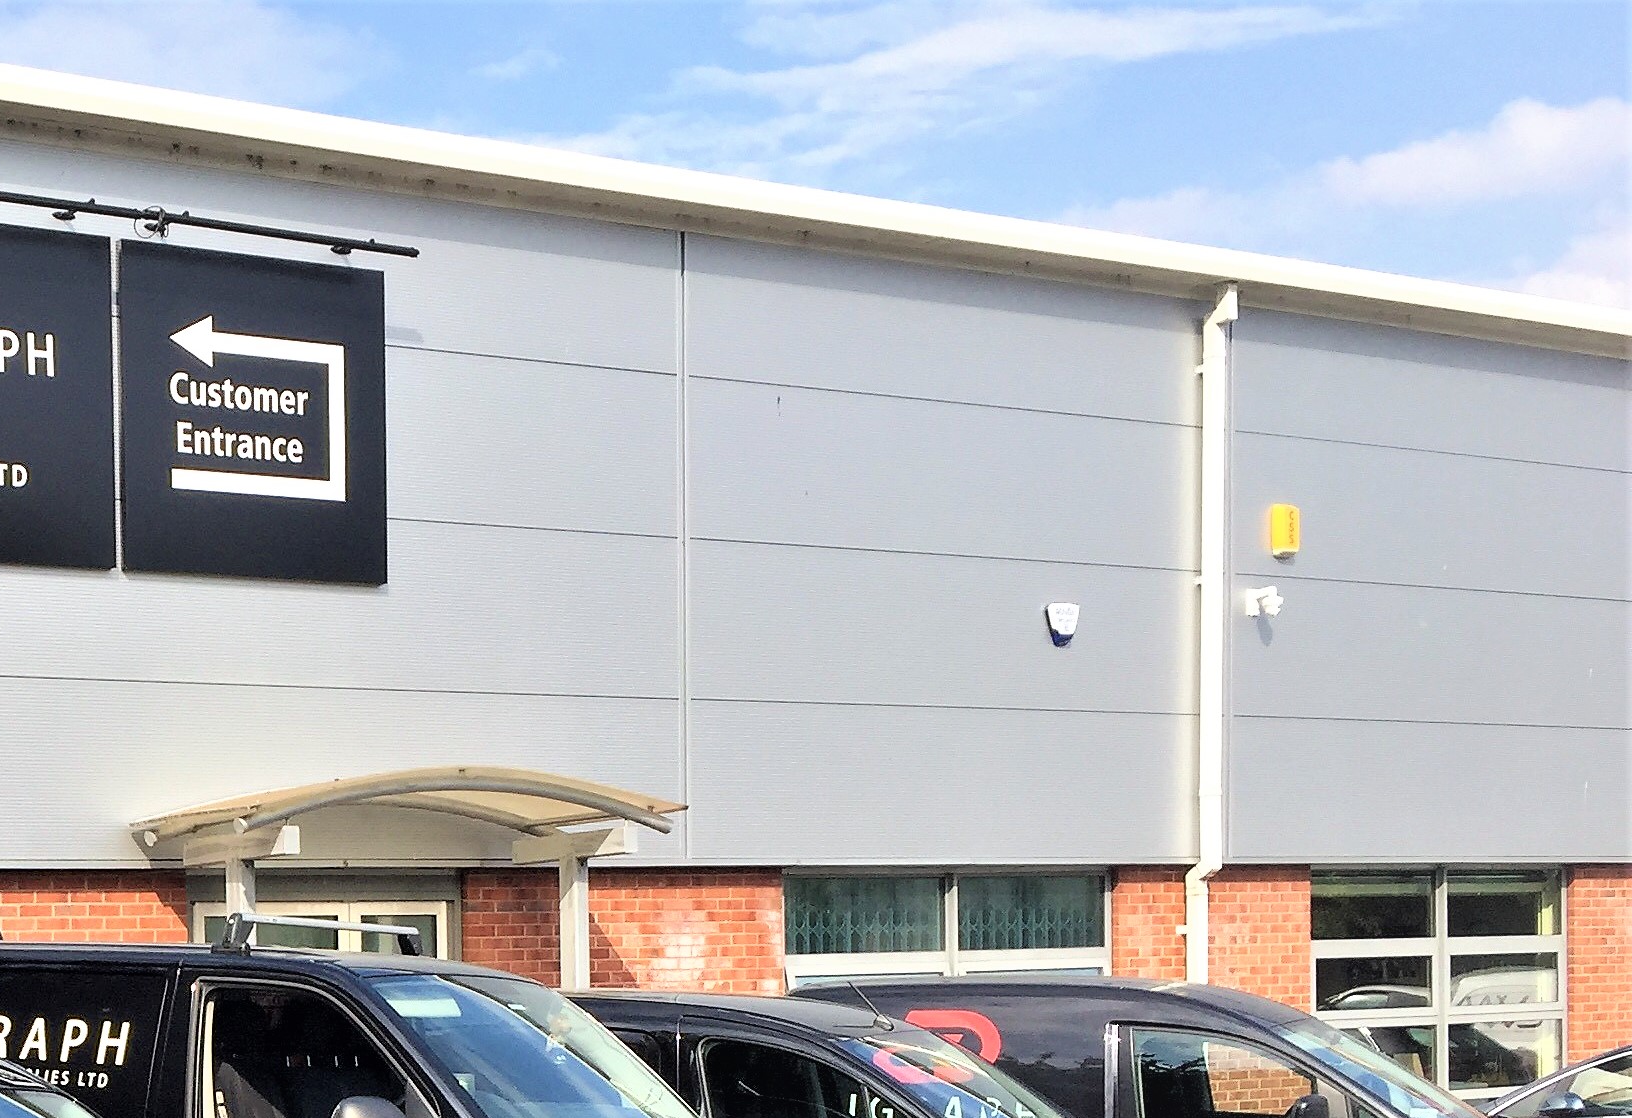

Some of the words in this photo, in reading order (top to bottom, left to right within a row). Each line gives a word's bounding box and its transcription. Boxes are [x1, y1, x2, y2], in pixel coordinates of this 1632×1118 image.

[169, 371, 309, 416] Customer
[176, 420, 304, 464] Entrance
[77, 1071, 109, 1089] LTD
